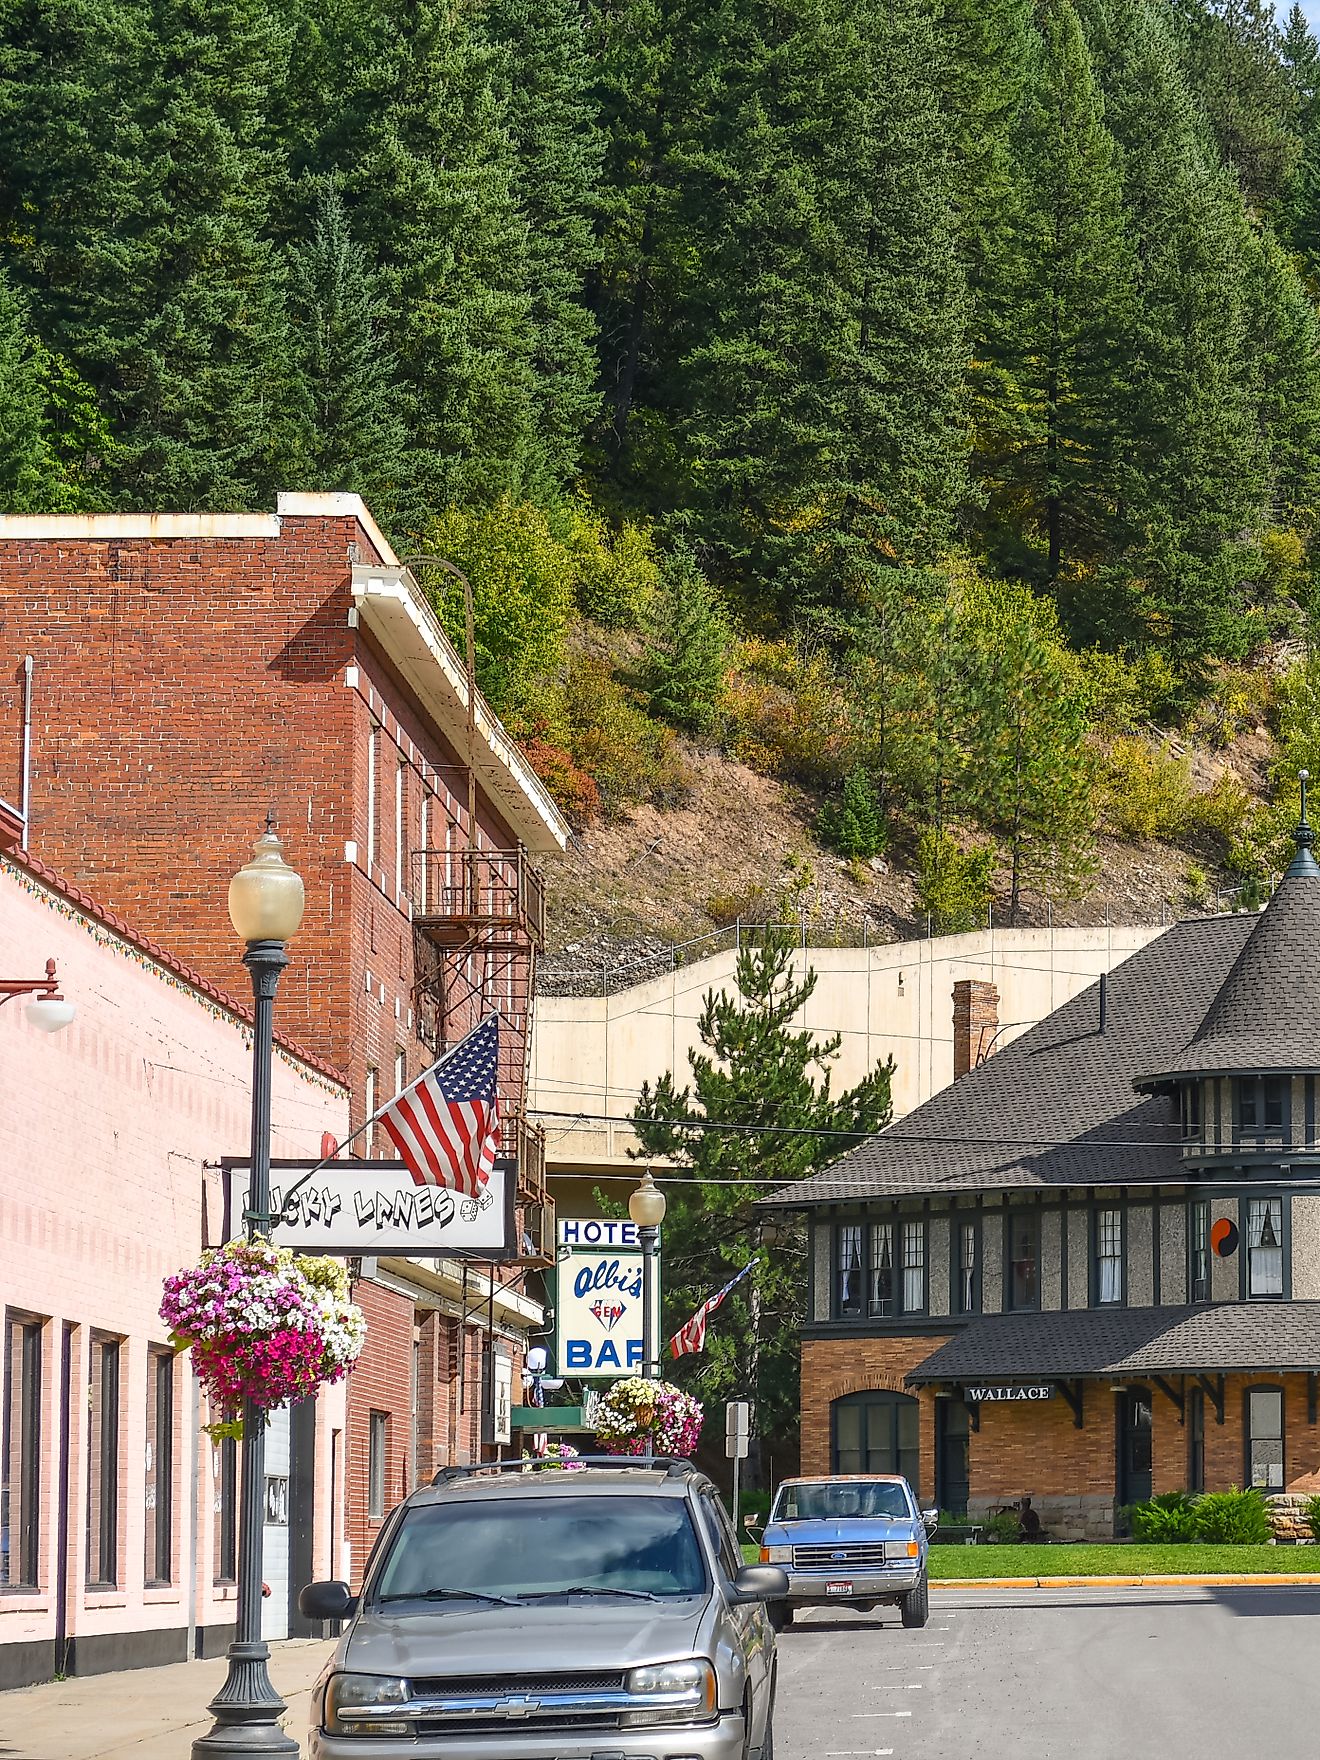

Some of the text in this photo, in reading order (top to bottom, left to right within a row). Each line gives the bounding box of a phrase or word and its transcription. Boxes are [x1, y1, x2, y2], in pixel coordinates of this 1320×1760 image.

[243, 1185, 455, 1236] UCKY LANES
[563, 1221, 641, 1244] HOTE
[969, 1387, 1050, 1401] WALLACE
